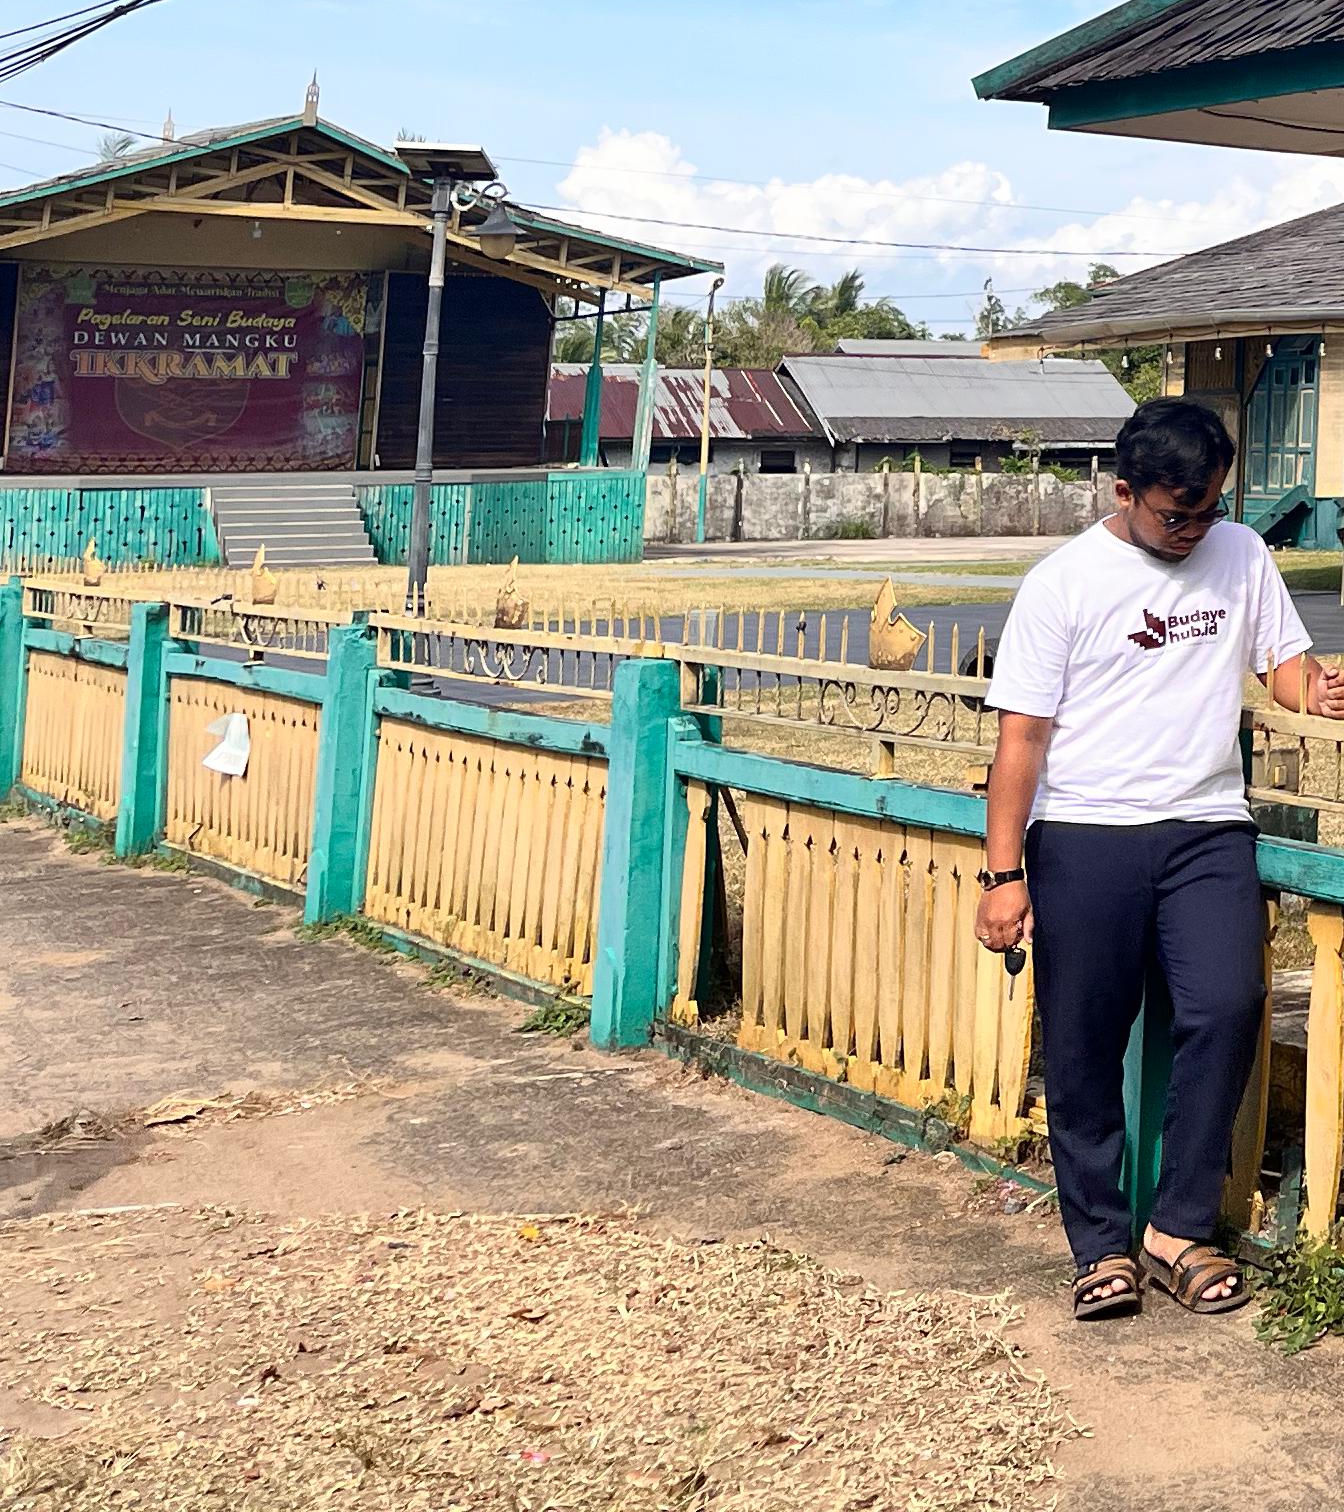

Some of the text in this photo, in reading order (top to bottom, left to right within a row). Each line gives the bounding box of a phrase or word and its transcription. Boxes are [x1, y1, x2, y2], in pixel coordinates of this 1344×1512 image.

[77, 307, 297, 331] Pagelaran Seni Budaya
[73, 330, 298, 348] DEWAN MANGKU
[70, 349, 299, 385] IKKRAMAT
[1168, 609, 1226, 629] Budaye
[1169, 622, 1218, 644] hub.id
